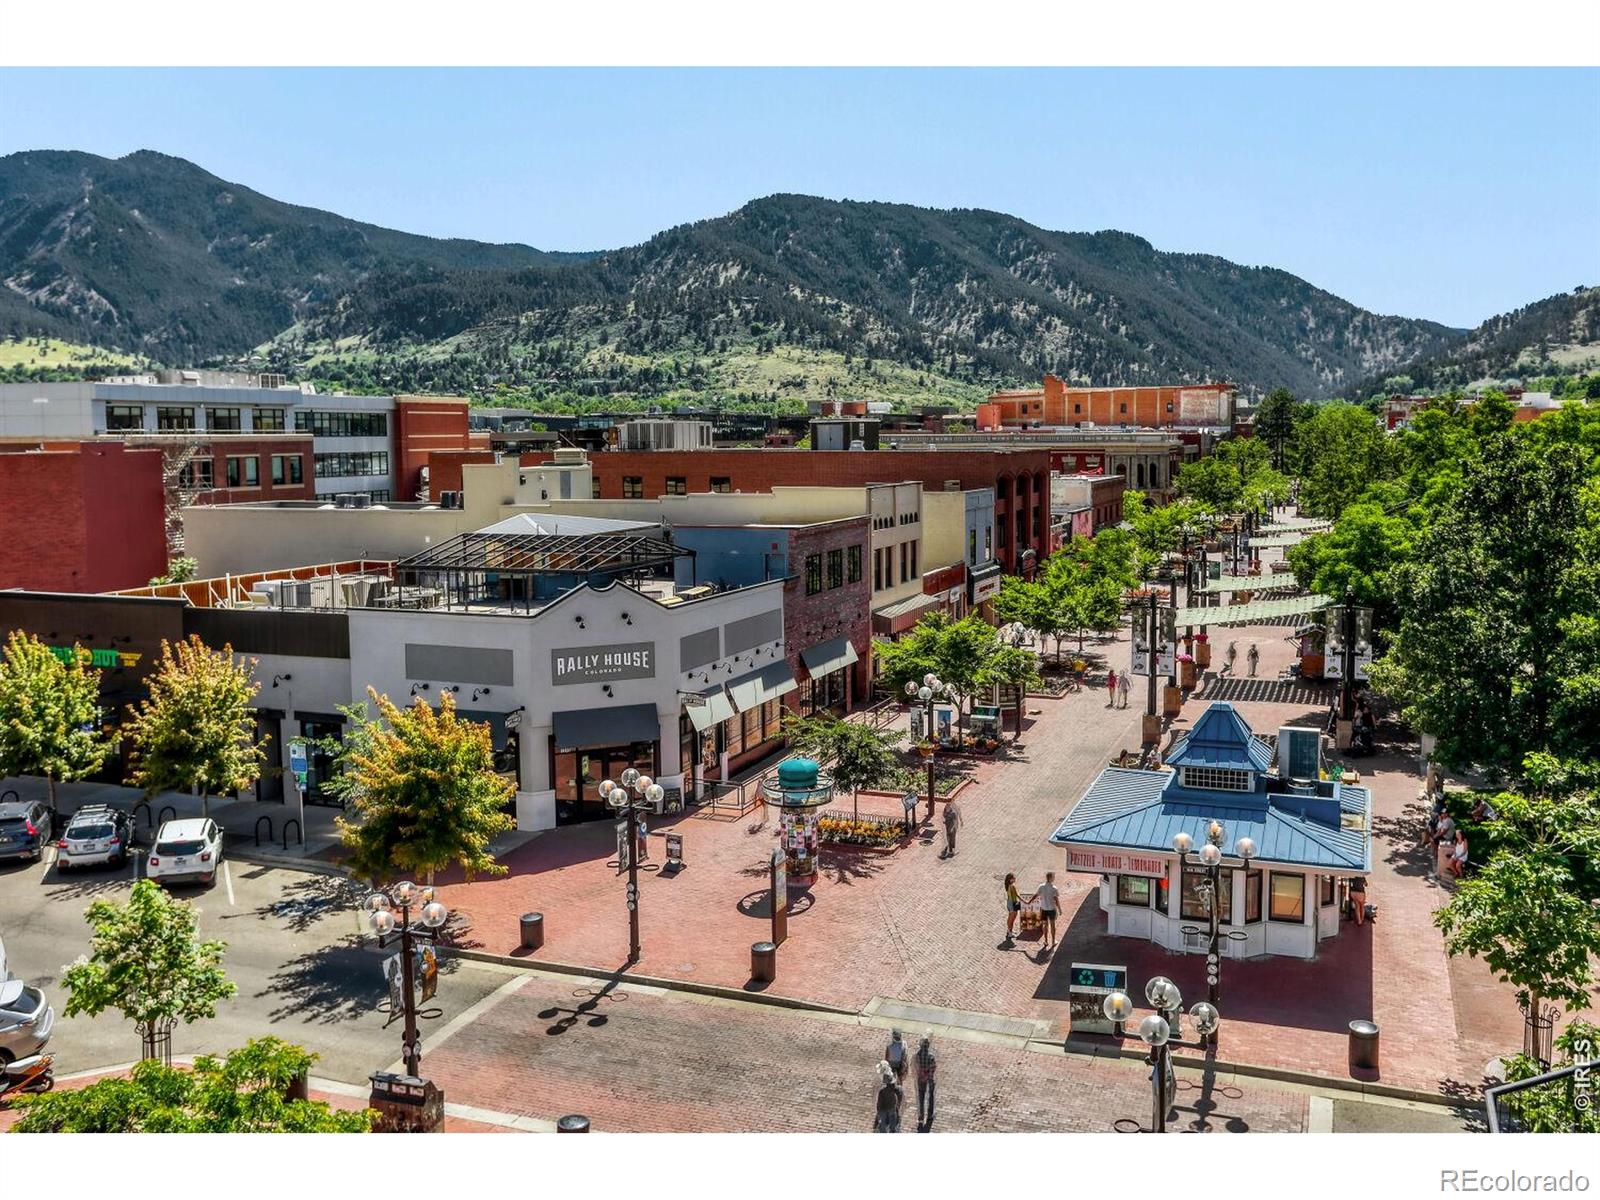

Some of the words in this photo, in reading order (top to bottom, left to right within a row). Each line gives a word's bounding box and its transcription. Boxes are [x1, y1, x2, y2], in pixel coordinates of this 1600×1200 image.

[92, 649, 118, 667] HUT
[557, 654, 600, 676] RALLY
[604, 651, 649, 669] HOUSE
[584, 667, 622, 675] COLORADO
